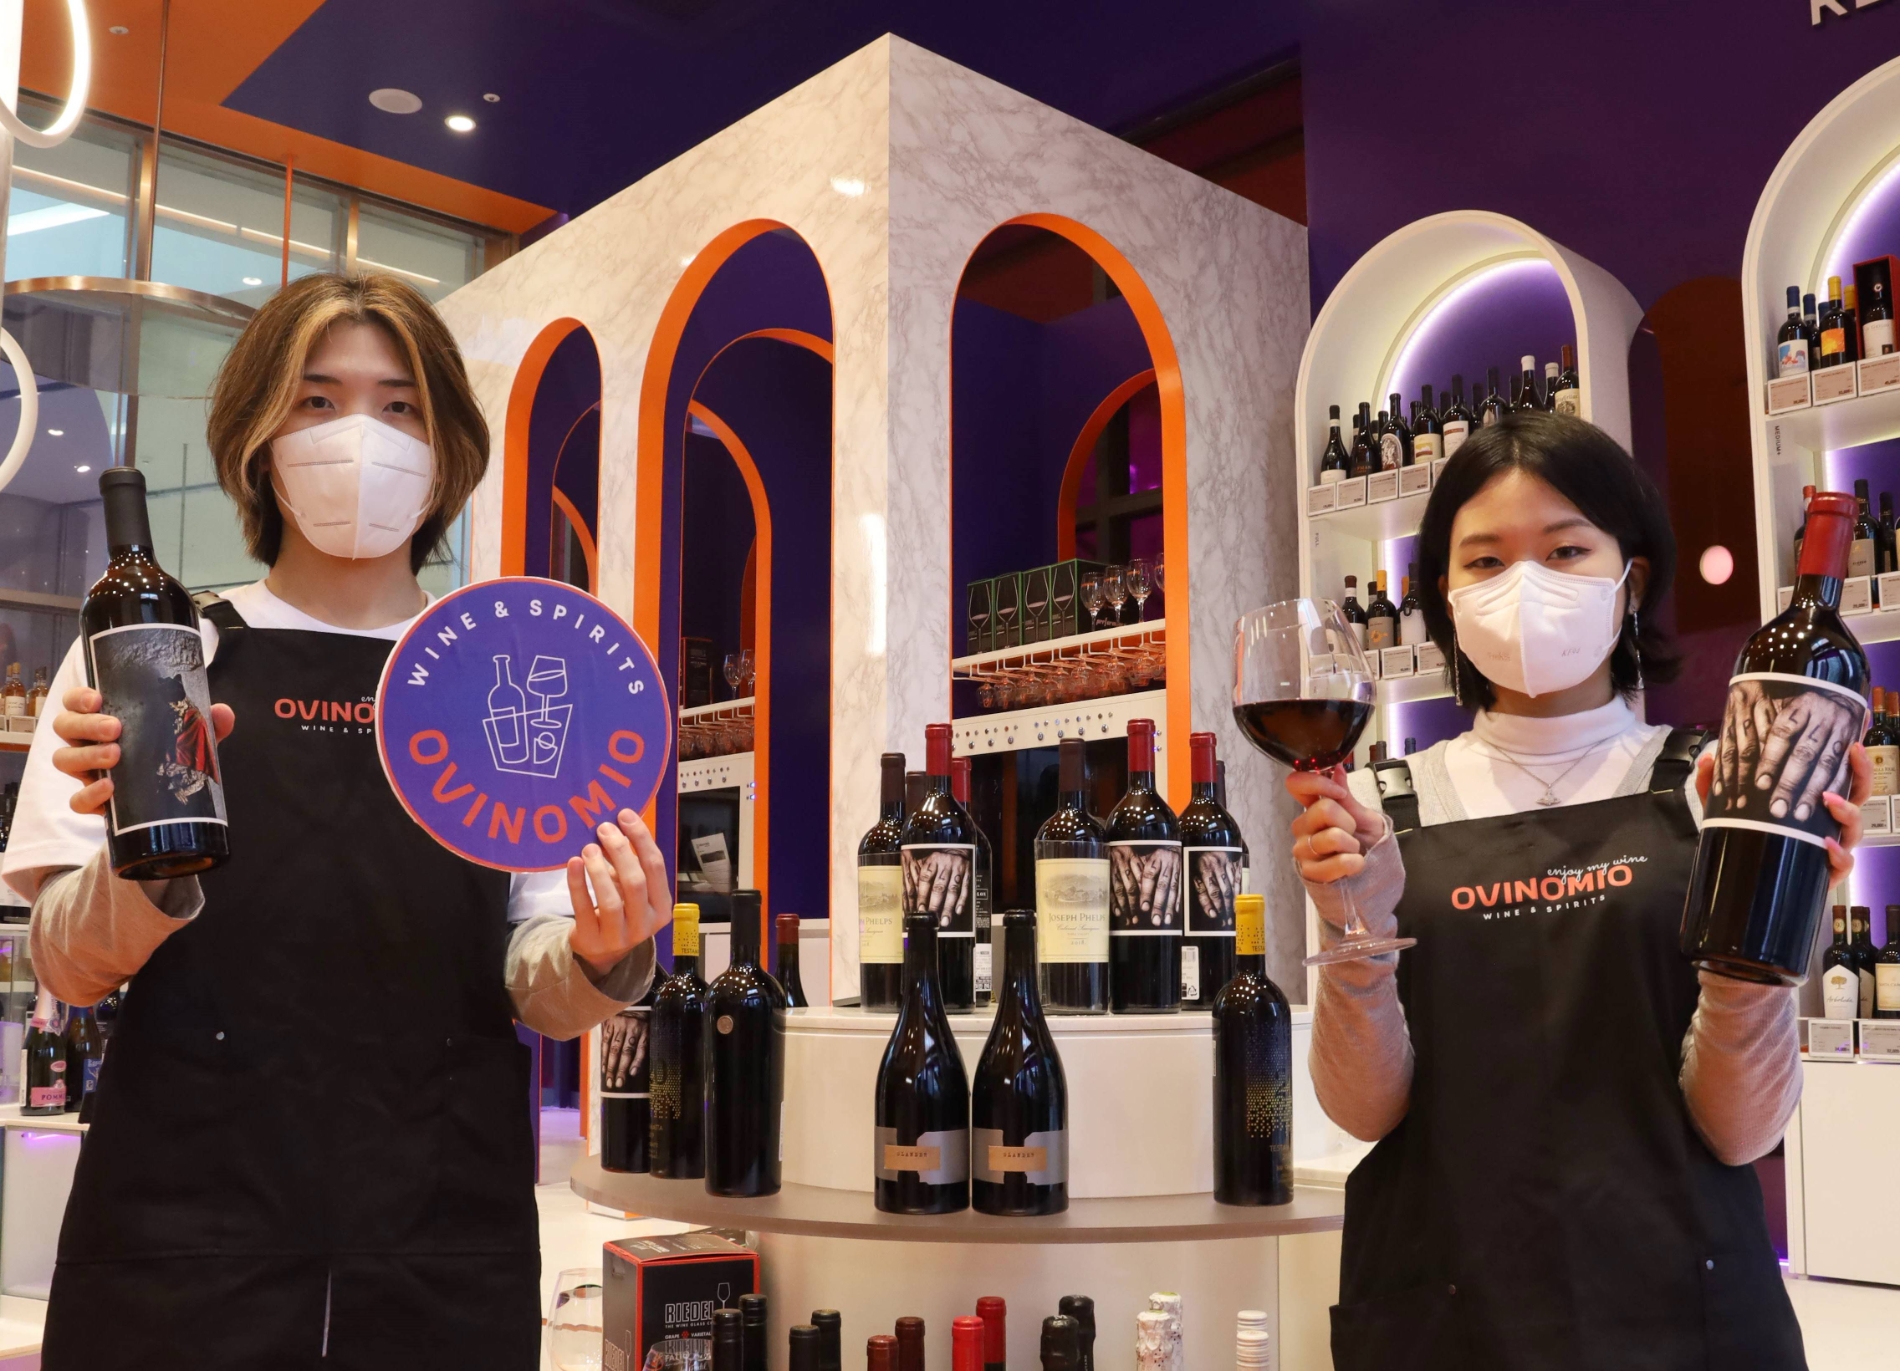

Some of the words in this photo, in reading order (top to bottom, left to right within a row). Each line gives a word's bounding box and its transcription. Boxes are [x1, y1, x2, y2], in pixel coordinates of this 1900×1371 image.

[407, 612, 477, 687] WINE
[494, 601, 510, 618] &
[529, 599, 645, 695] SPIRITS
[274, 698, 375, 724] OVINO
[301, 725, 334, 733] WINE
[409, 729, 645, 845] OVINOMIO
[1547, 865, 1584, 885] enjoy
[1587, 861, 1610, 876] my
[1613, 854, 1648, 866] wine
[1451, 864, 1633, 910] OVINOMIO
[1049, 912, 1077, 922] JOSEPH
[1483, 908, 1520, 920] WINE
[1530, 906, 1536, 914] &
[1546, 894, 1606, 913] SPIRITS
[866, 917, 892, 925] PHELPS
[665, 1300, 714, 1323] RIEDEL
